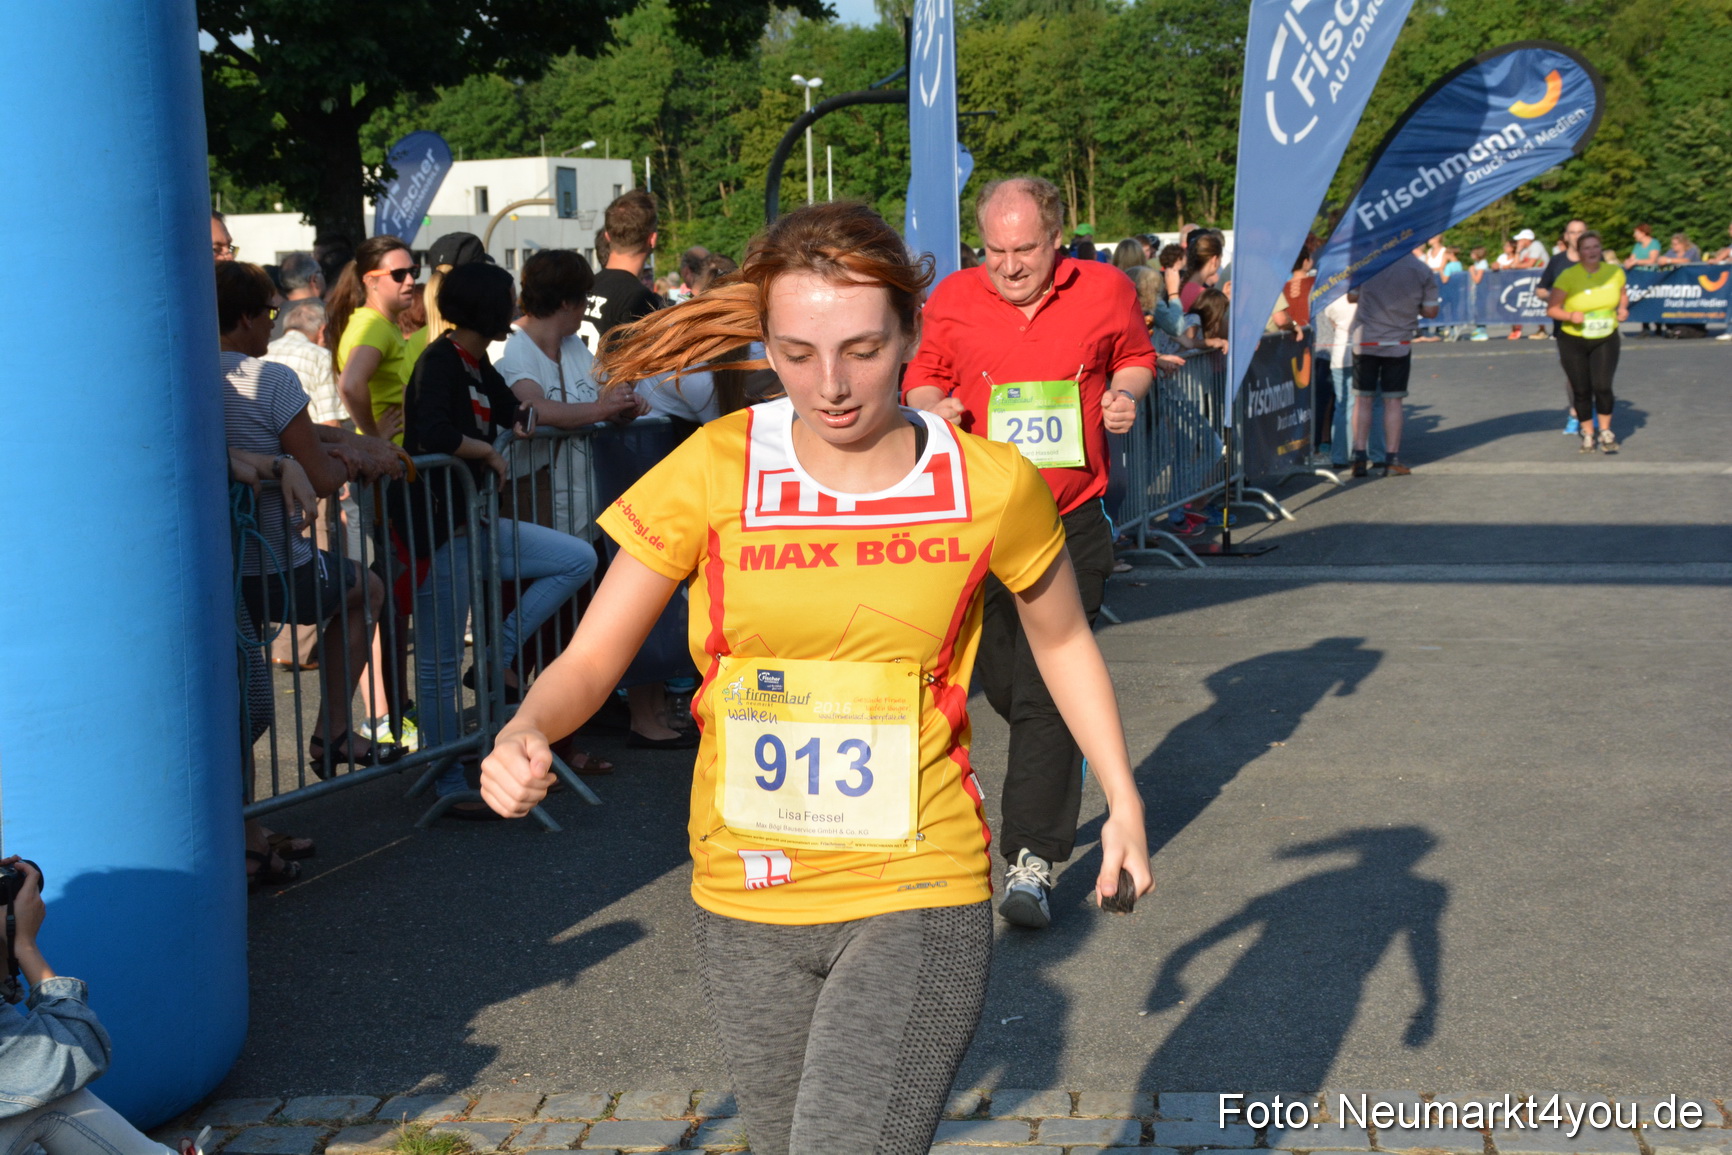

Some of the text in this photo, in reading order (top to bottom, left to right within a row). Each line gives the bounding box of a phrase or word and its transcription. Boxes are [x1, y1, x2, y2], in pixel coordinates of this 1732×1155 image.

[1464, 152, 1507, 186] Druck
[1535, 107, 1588, 147] Medien
[391, 147, 436, 230] Fischer
[1356, 122, 1527, 231] Frischmann
[405, 163, 441, 228] AUTOMOBILE
[1006, 416, 1063, 444] 250
[740, 532, 970, 571] MAX BÖGL
[746, 687, 812, 705] firmenlauf
[813, 702, 853, 714] 2016
[728, 707, 778, 725] walken
[754, 733, 875, 797] 913
[768, 823, 782, 831] Bögl
[778, 808, 844, 823] Lisa Fessel
